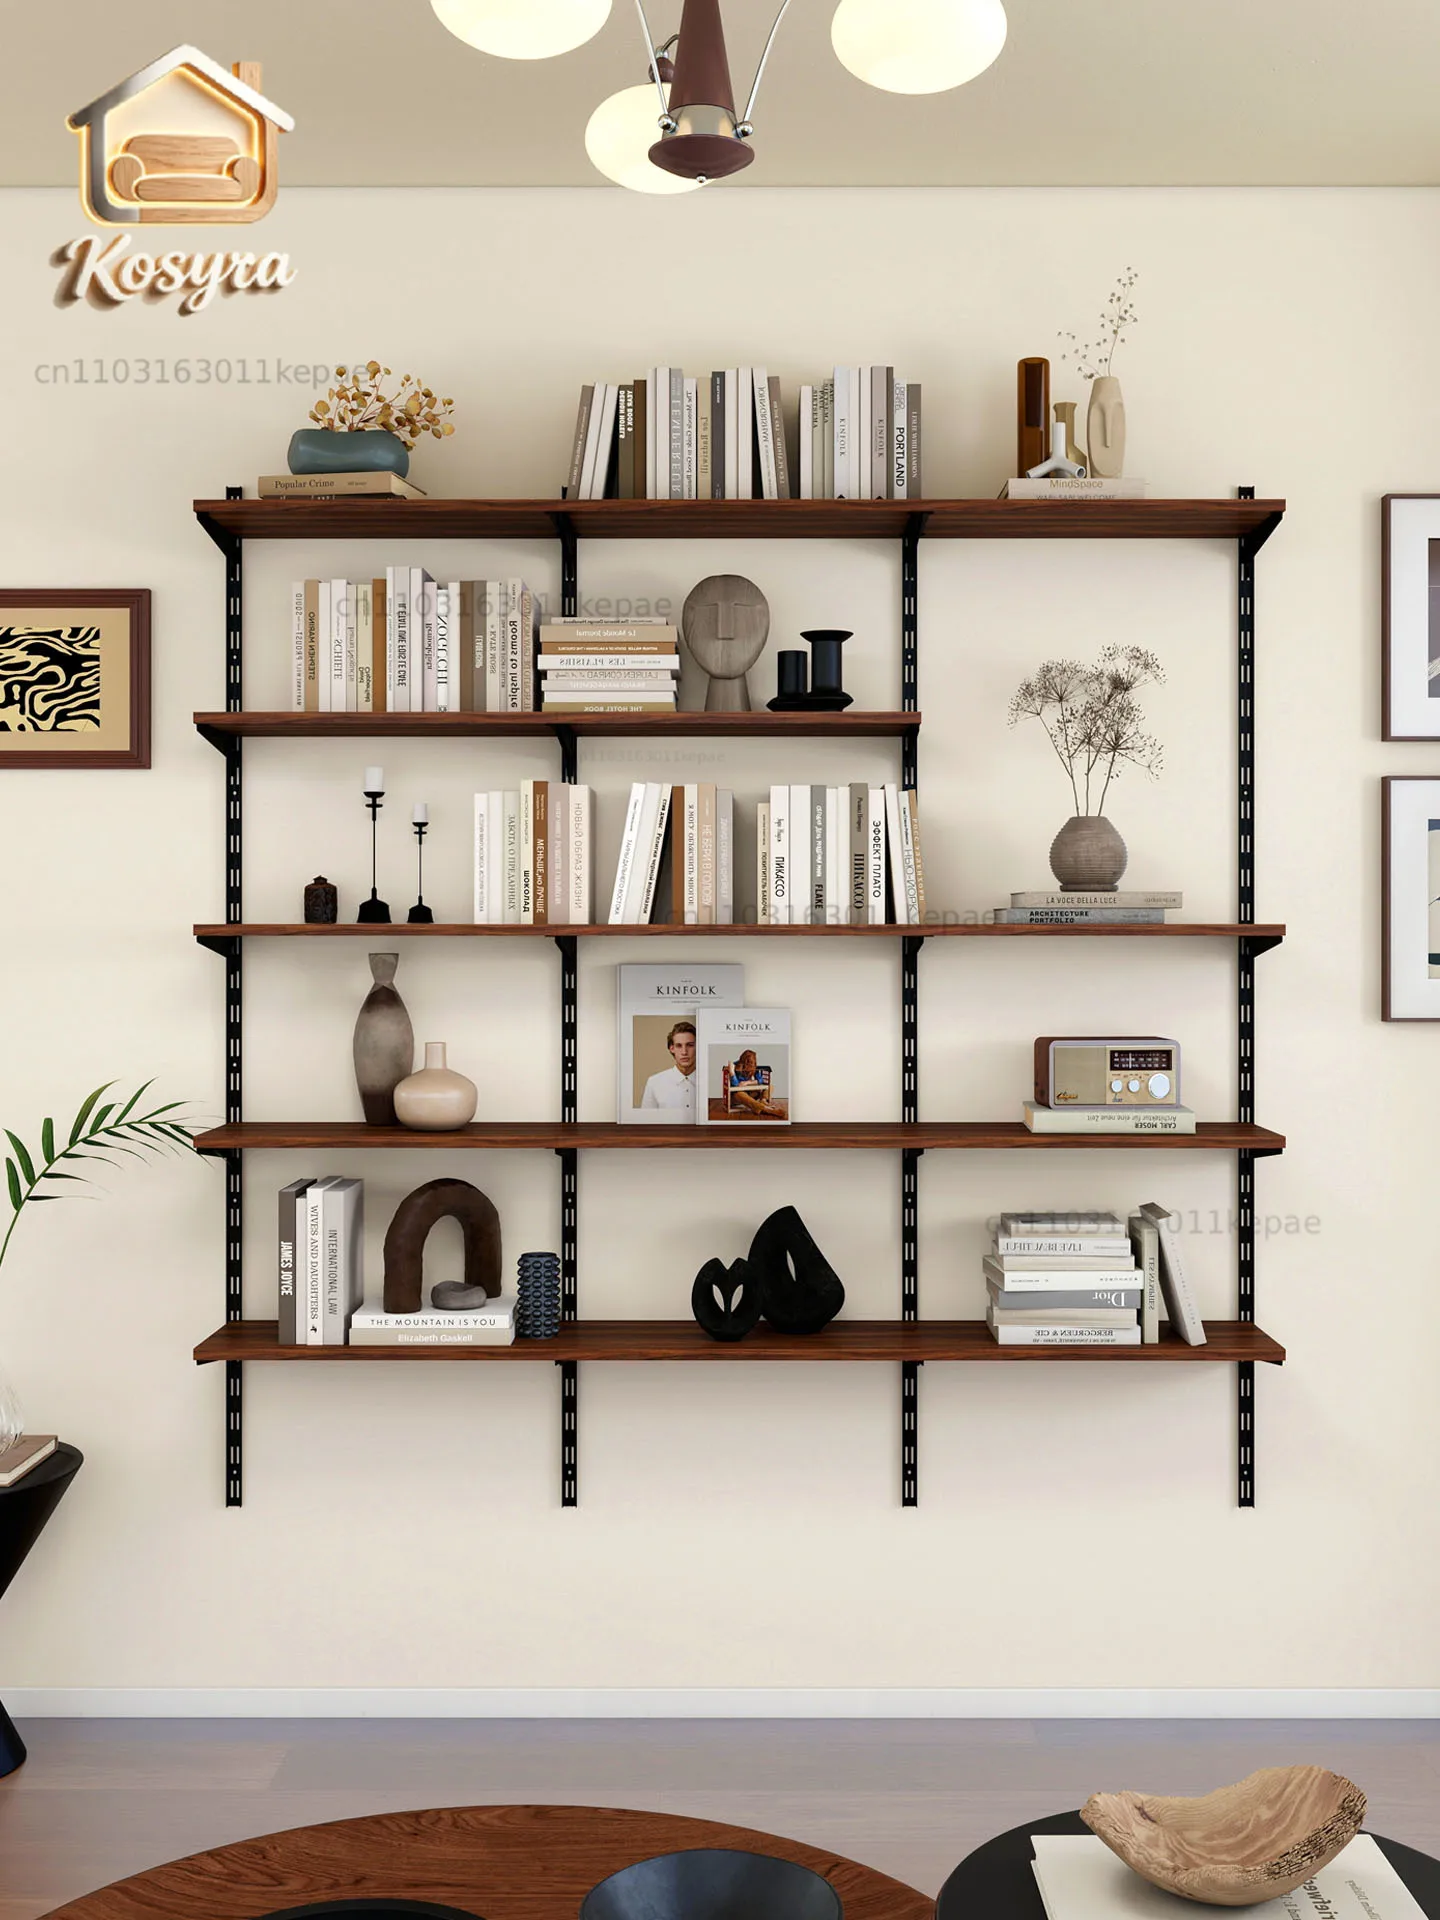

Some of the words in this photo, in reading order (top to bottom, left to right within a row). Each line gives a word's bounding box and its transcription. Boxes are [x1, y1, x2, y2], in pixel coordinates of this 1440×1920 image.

[895, 427, 905, 488] PORTLAND
[275, 480, 307, 490] Popular
[309, 479, 335, 488] Crime
[1050, 479, 1104, 489] MindSpace
[507, 814, 516, 845] ЗАБОТА
[574, 803, 583, 838] НОВЫЙ
[702, 824, 712, 836] НЕ
[574, 840, 583, 870] ОБРАЗ
[872, 821, 881, 860] ЭФФЕКТ
[507, 857, 516, 910] ПРЕДАННЫХ
[574, 873, 583, 909] ЖИЗНИ
[775, 856, 784, 898] ПИКАССО
[854, 853, 865, 909] ПИКАССО
[872, 864, 881, 898] ПЛАТО
[535, 886, 545, 913] ЛУЧШЕ
[815, 884, 823, 909] FLAKE
[656, 985, 716, 995] KINFOLK
[310, 1205, 318, 1236] WIVES
[281, 1241, 292, 1268] JAMES
[310, 1238, 318, 1258] AND
[328, 1229, 337, 1294] INTERNATIONAL
[281, 1270, 292, 1295] JOYCE
[310, 1260, 318, 1319] DAUGHTERS
[328, 1298, 337, 1315] LAW
[1092, 1292, 1125, 1307] Dior
[397, 1334, 438, 1342] Elizabeth
[440, 1334, 473, 1342] Gaskell
